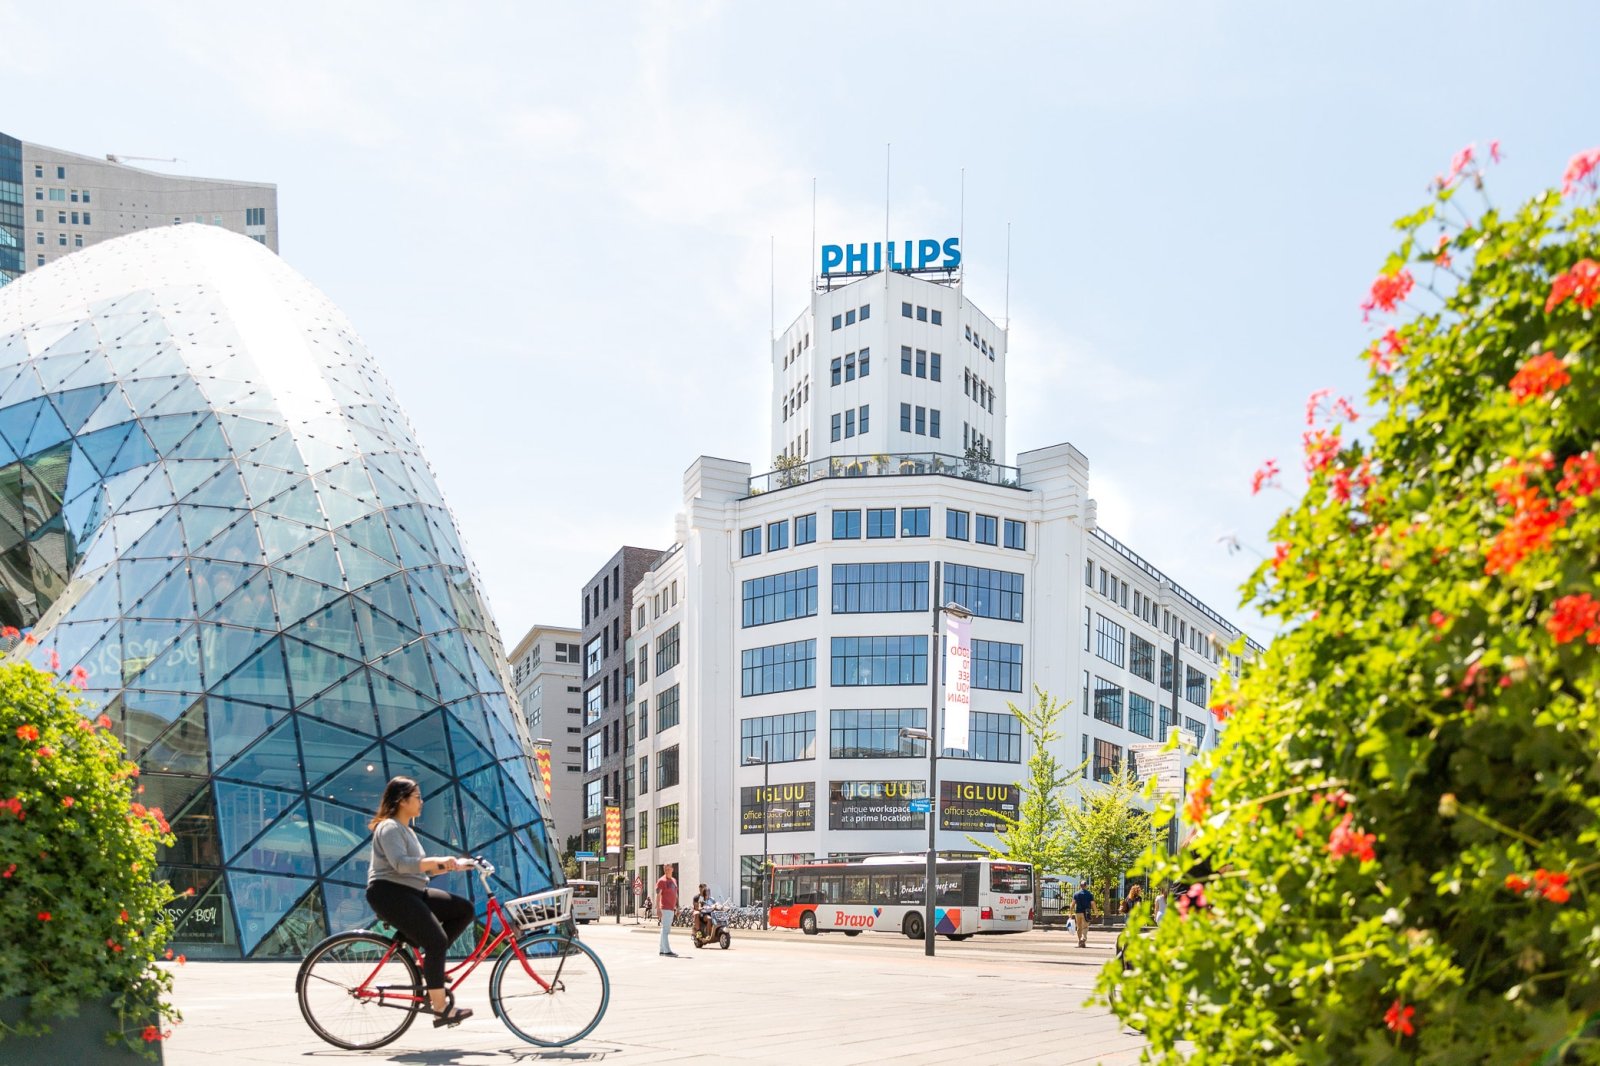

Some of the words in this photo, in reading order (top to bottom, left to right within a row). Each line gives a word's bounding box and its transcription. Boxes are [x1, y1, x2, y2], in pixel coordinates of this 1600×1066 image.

[822, 237, 961, 274] PHILIPS
[756, 785, 805, 802] IGLUU
[849, 782, 910, 798] IGLUU
[957, 784, 1008, 801] IGLUU
[842, 805, 868, 814] unique
[869, 805, 911, 814] workspace
[944, 807, 965, 816] office
[855, 815, 879, 823] prime
[880, 814, 912, 822] location
[999, 896, 1019, 905] Bravo
[834, 911, 875, 928] Bravo
